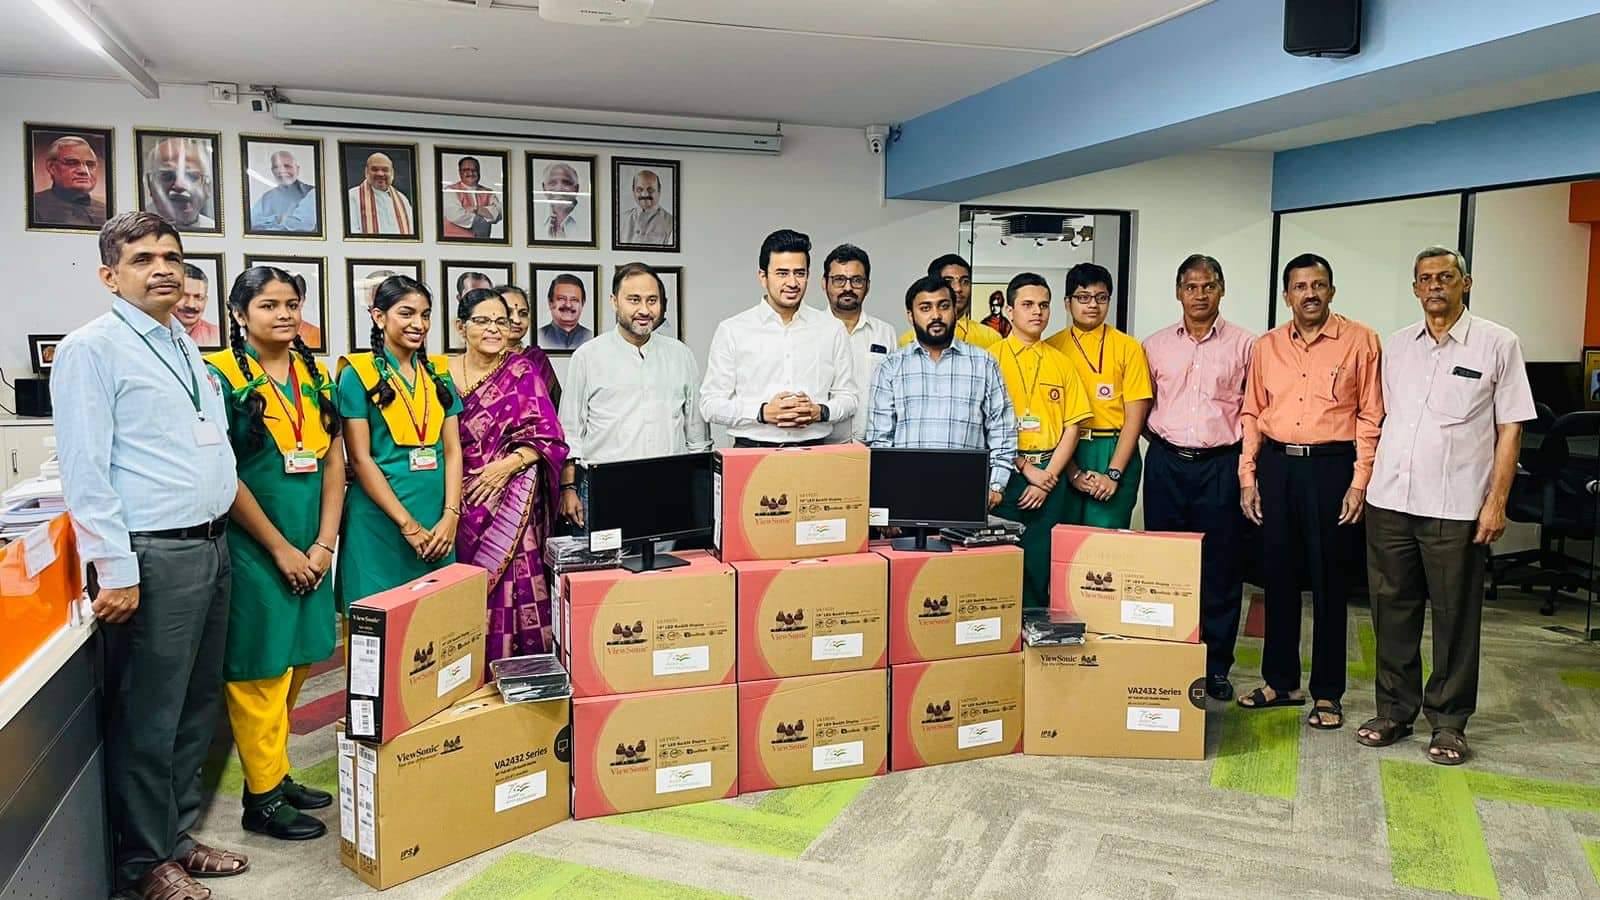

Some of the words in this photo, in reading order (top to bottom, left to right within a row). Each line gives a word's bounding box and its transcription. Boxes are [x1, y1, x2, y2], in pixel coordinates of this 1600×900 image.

[1127, 687, 1157, 695] VA2432
[396, 743, 440, 763] ViewSonic
[494, 754, 525, 770] VA2432
[525, 747, 548, 760] Series
[400, 848, 414, 859] IPS
